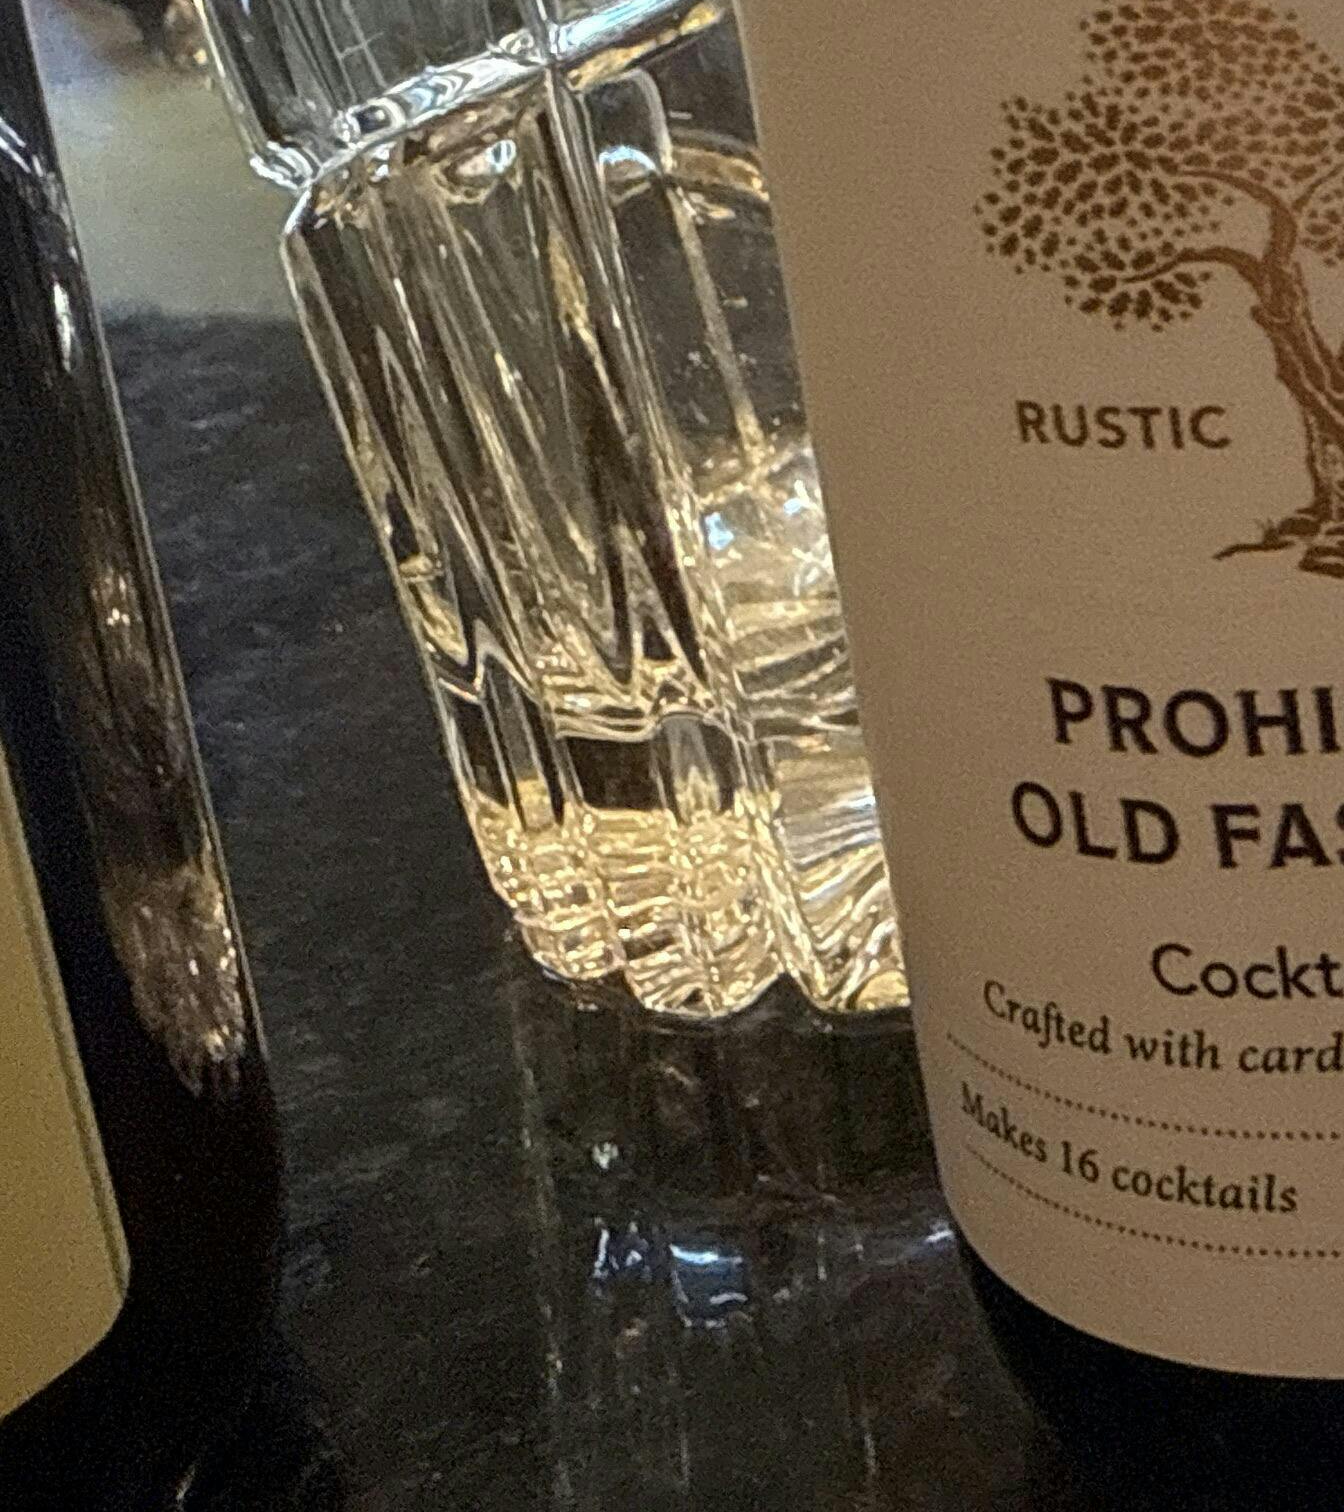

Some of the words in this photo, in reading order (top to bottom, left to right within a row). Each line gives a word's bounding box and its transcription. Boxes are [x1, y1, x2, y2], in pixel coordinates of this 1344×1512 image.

[1014, 400, 1233, 451] RUSTIC
[1011, 781, 1181, 866] OLD
[983, 980, 1112, 1055] Crafted
[1124, 1028, 1221, 1071] with
[960, 1083, 1048, 1163] Makes
[1061, 1141, 1100, 1183] 16
[1111, 1164, 1298, 1214] cocktails
